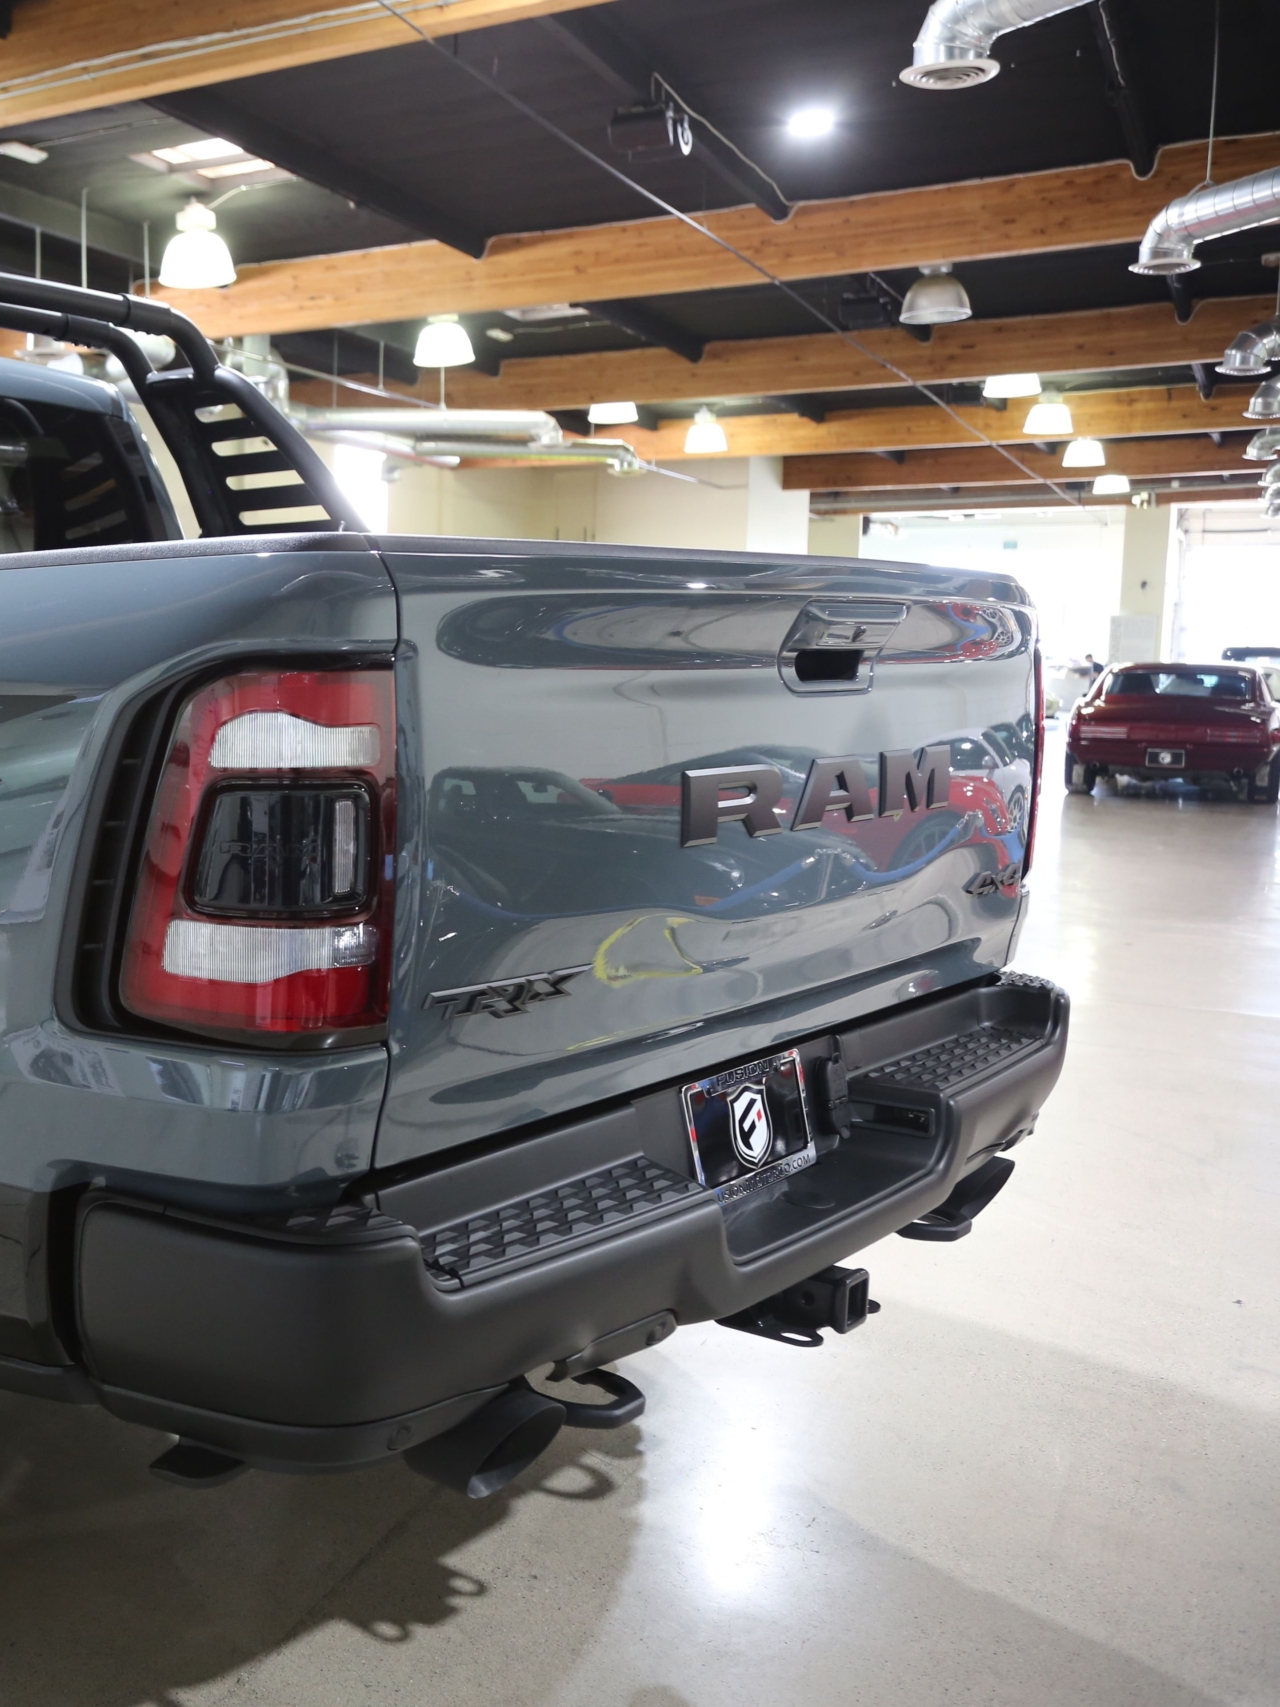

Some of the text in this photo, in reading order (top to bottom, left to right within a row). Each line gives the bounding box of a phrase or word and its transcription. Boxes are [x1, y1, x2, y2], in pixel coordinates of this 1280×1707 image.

[680, 744, 951, 849] RAM
[219, 841, 320, 858] RAM
[422, 963, 595, 1020] TRX
[716, 1059, 770, 1087] FUSION
[717, 1153, 812, 1204] USIONMOTORCO.COM
